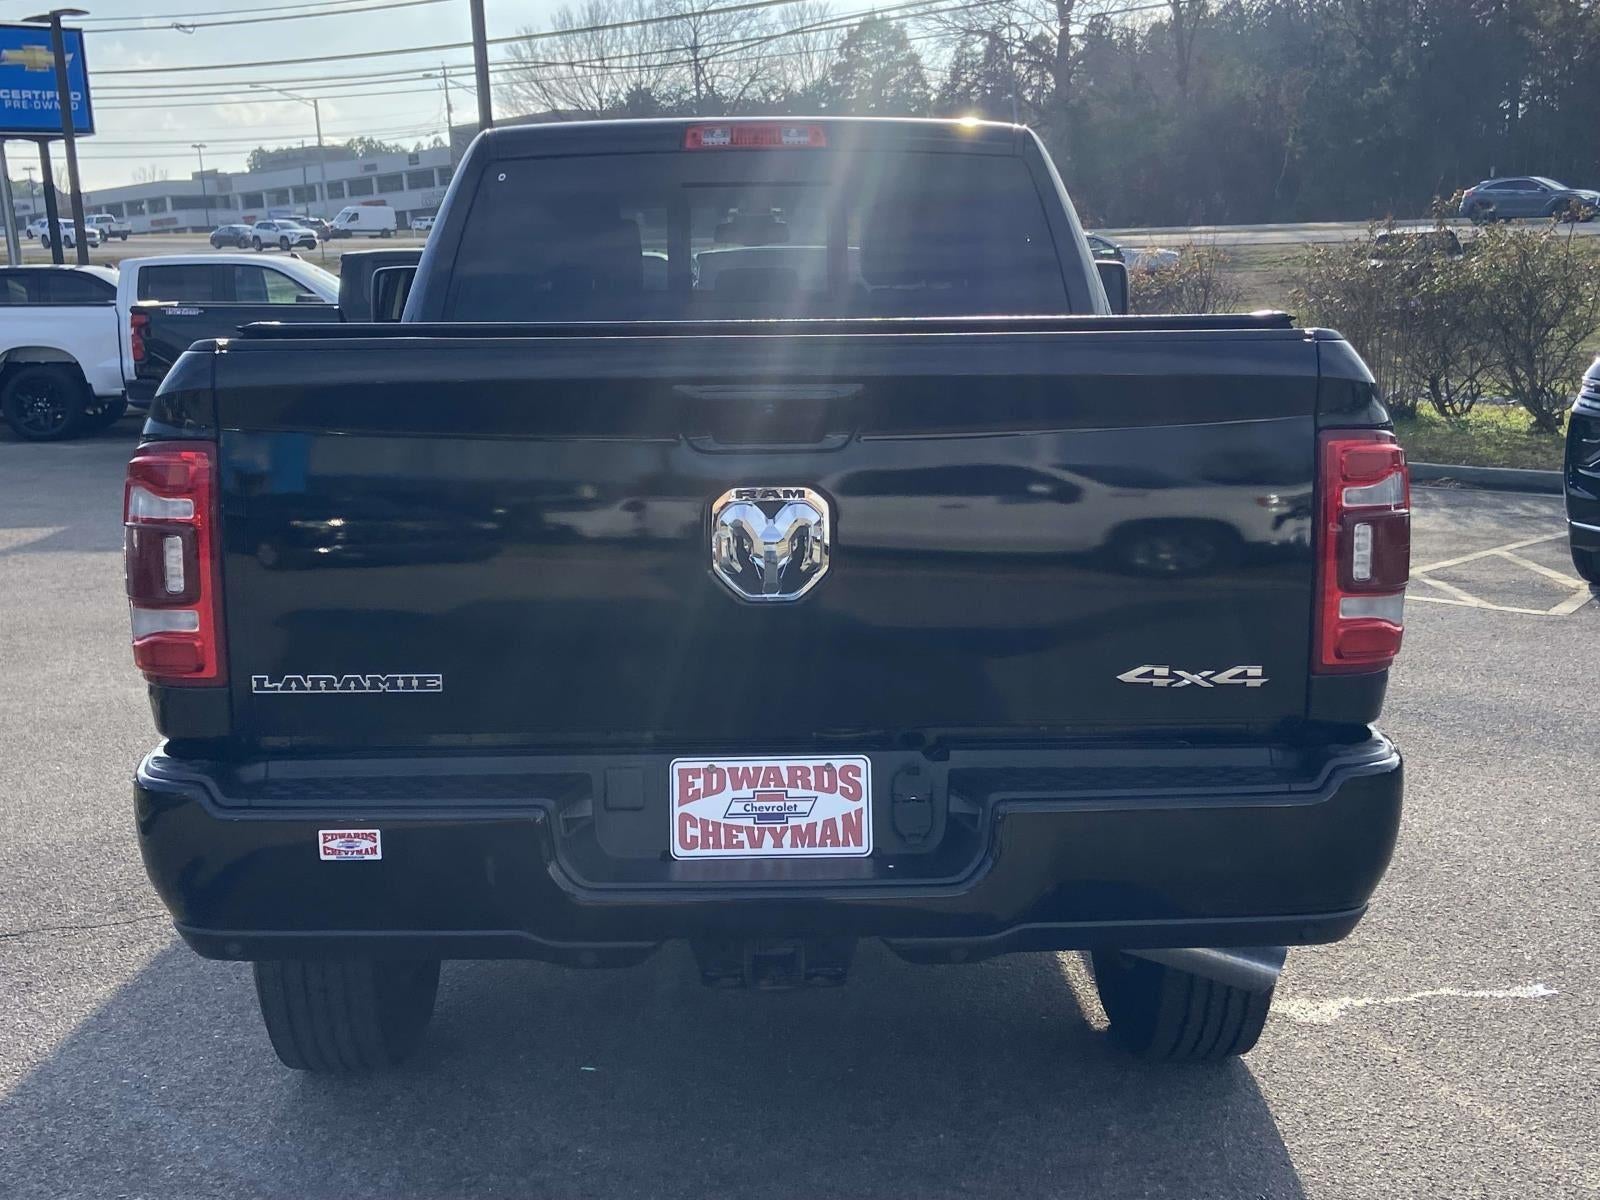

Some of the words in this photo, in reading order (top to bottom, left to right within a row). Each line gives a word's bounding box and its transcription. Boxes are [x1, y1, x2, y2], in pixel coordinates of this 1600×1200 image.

[0, 89, 82, 101] CERTIFID
[4, 100, 79, 111] PRE-OWND
[735, 489, 806, 499] RAM
[251, 674, 443, 693] LARAMIE
[677, 764, 863, 808] EDWARDS
[743, 802, 798, 813] Chevrolet
[677, 807, 864, 851] CHEVYMAN
[322, 832, 377, 845] EDWARDS
[322, 845, 378, 856] CHEVYMAN
